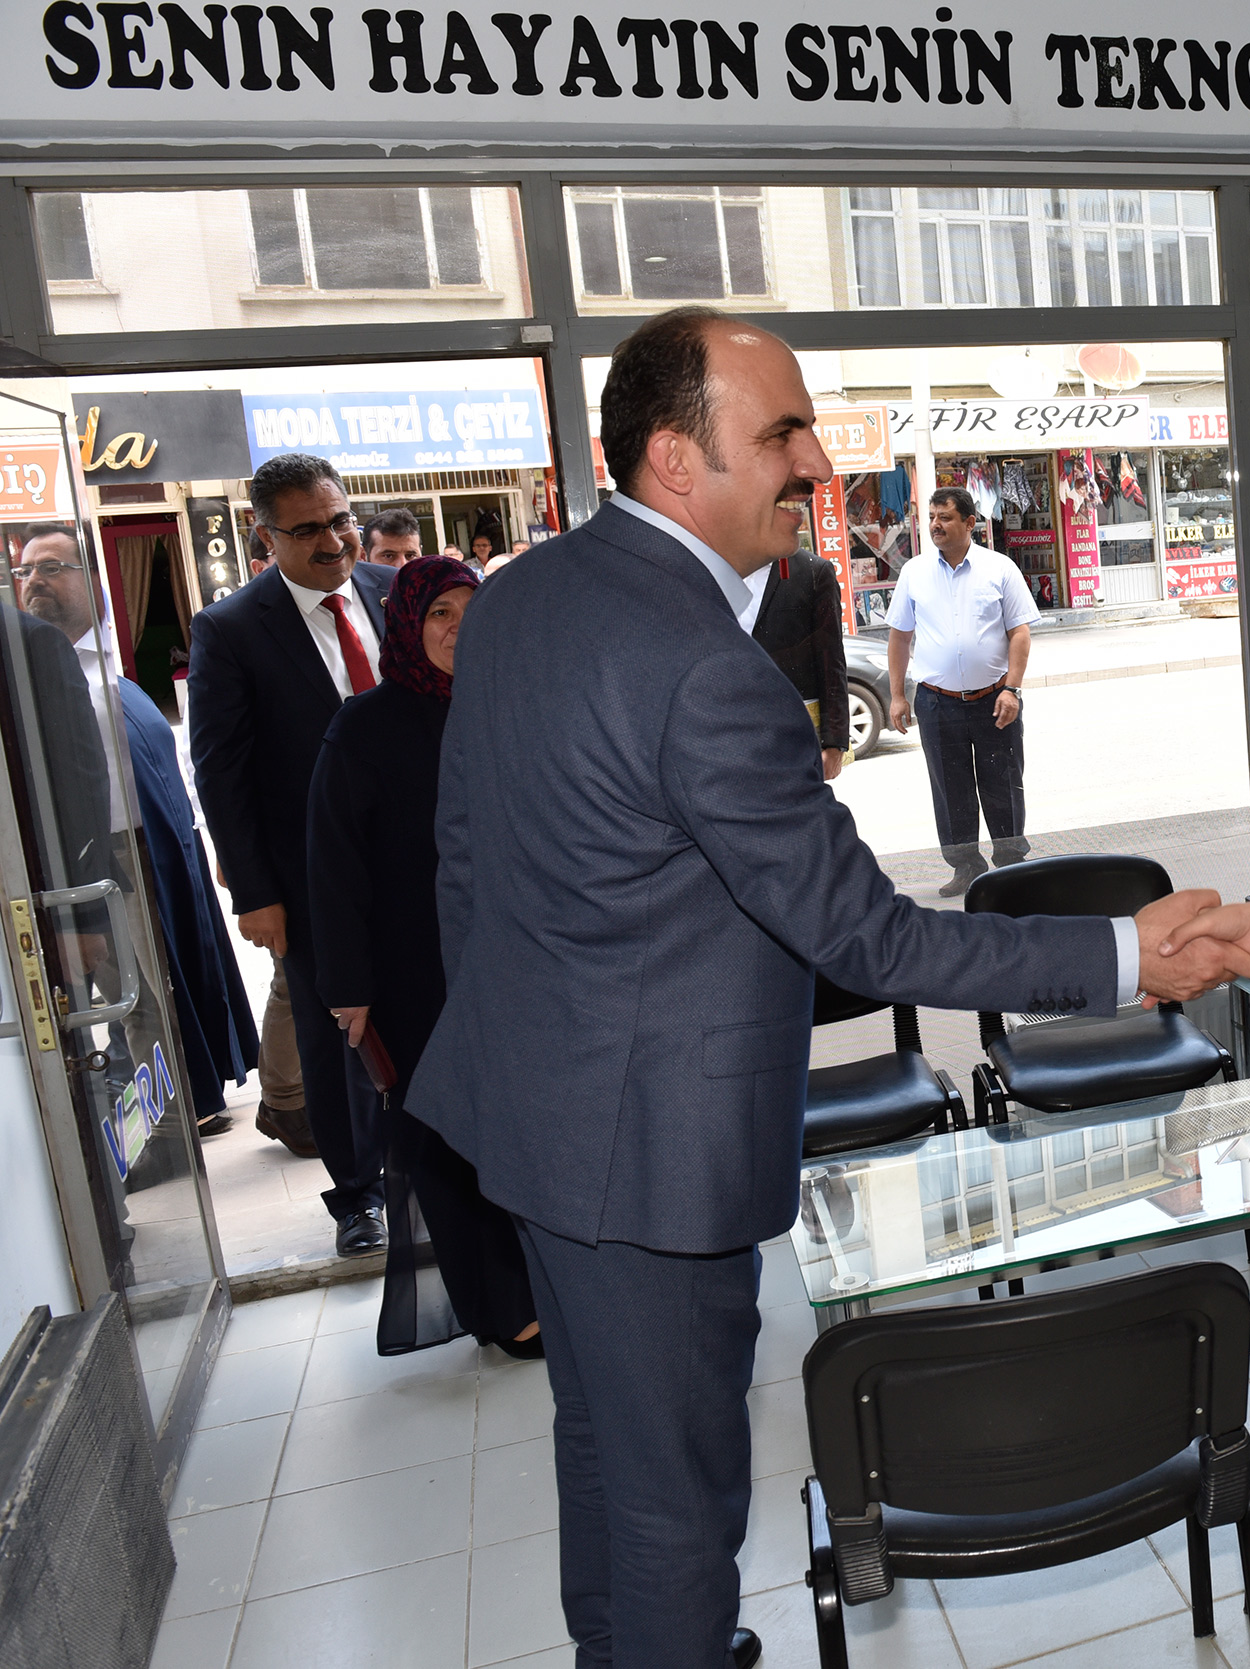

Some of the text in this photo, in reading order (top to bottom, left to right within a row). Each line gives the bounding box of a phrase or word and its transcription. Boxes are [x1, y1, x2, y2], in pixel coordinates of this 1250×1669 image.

[362, 9, 758, 99] HAYATIN
[785, 7, 1012, 104] SENİN
[252, 392, 533, 451] MODA TERZİ & ÇEYİZ
[1014, 404, 1139, 437] EŞARP
[1071, 541, 1096, 552] BANDANA
[1166, 524, 1204, 543] İLKER
